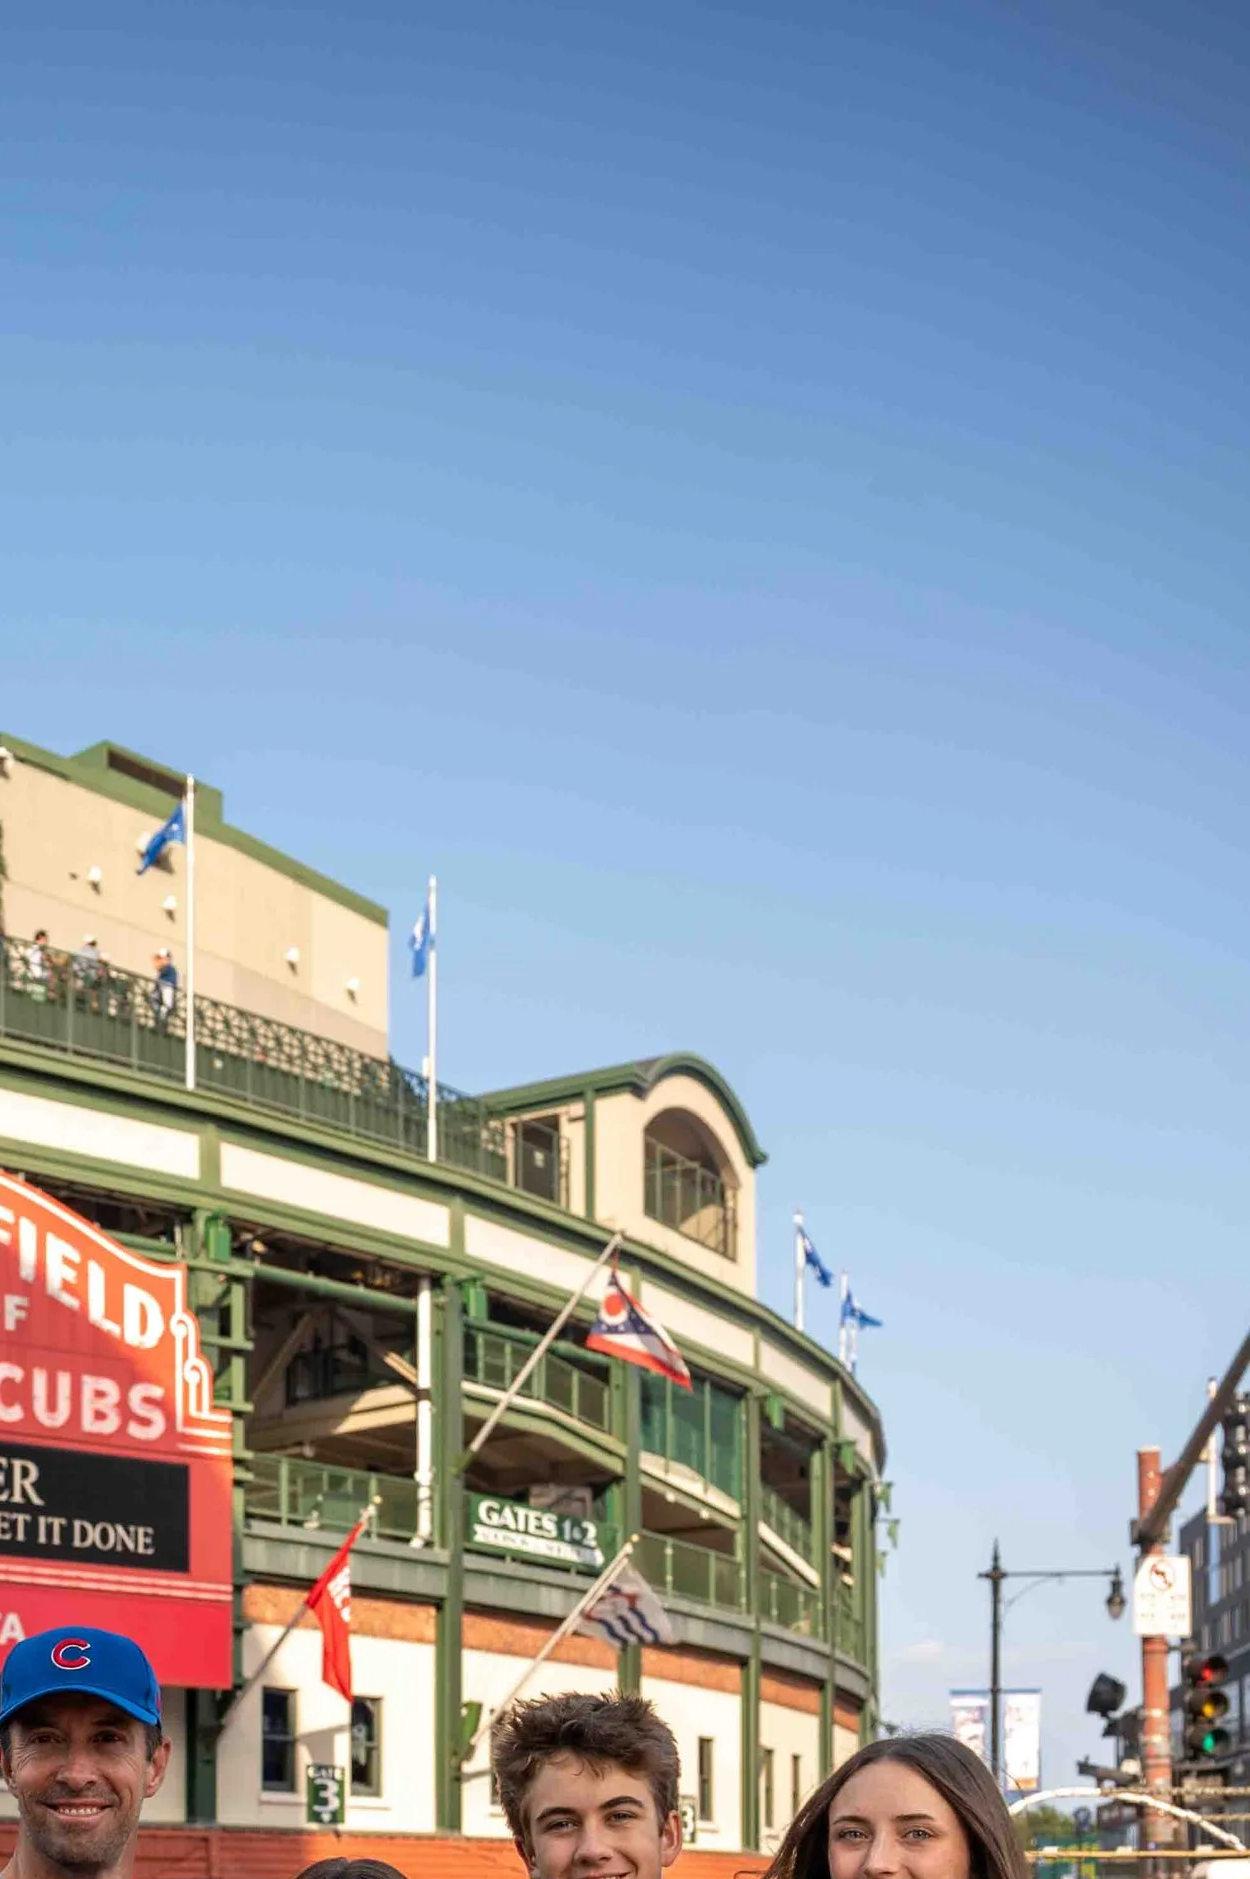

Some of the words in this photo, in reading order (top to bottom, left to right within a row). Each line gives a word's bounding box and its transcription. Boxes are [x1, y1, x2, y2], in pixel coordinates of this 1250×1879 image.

[37, 1515, 67, 1546] IT
[72, 1519, 156, 1555] DONE
[477, 1499, 558, 1539] GATES
[50, 1637, 92, 1670] C
[312, 1778, 340, 1812] 3
